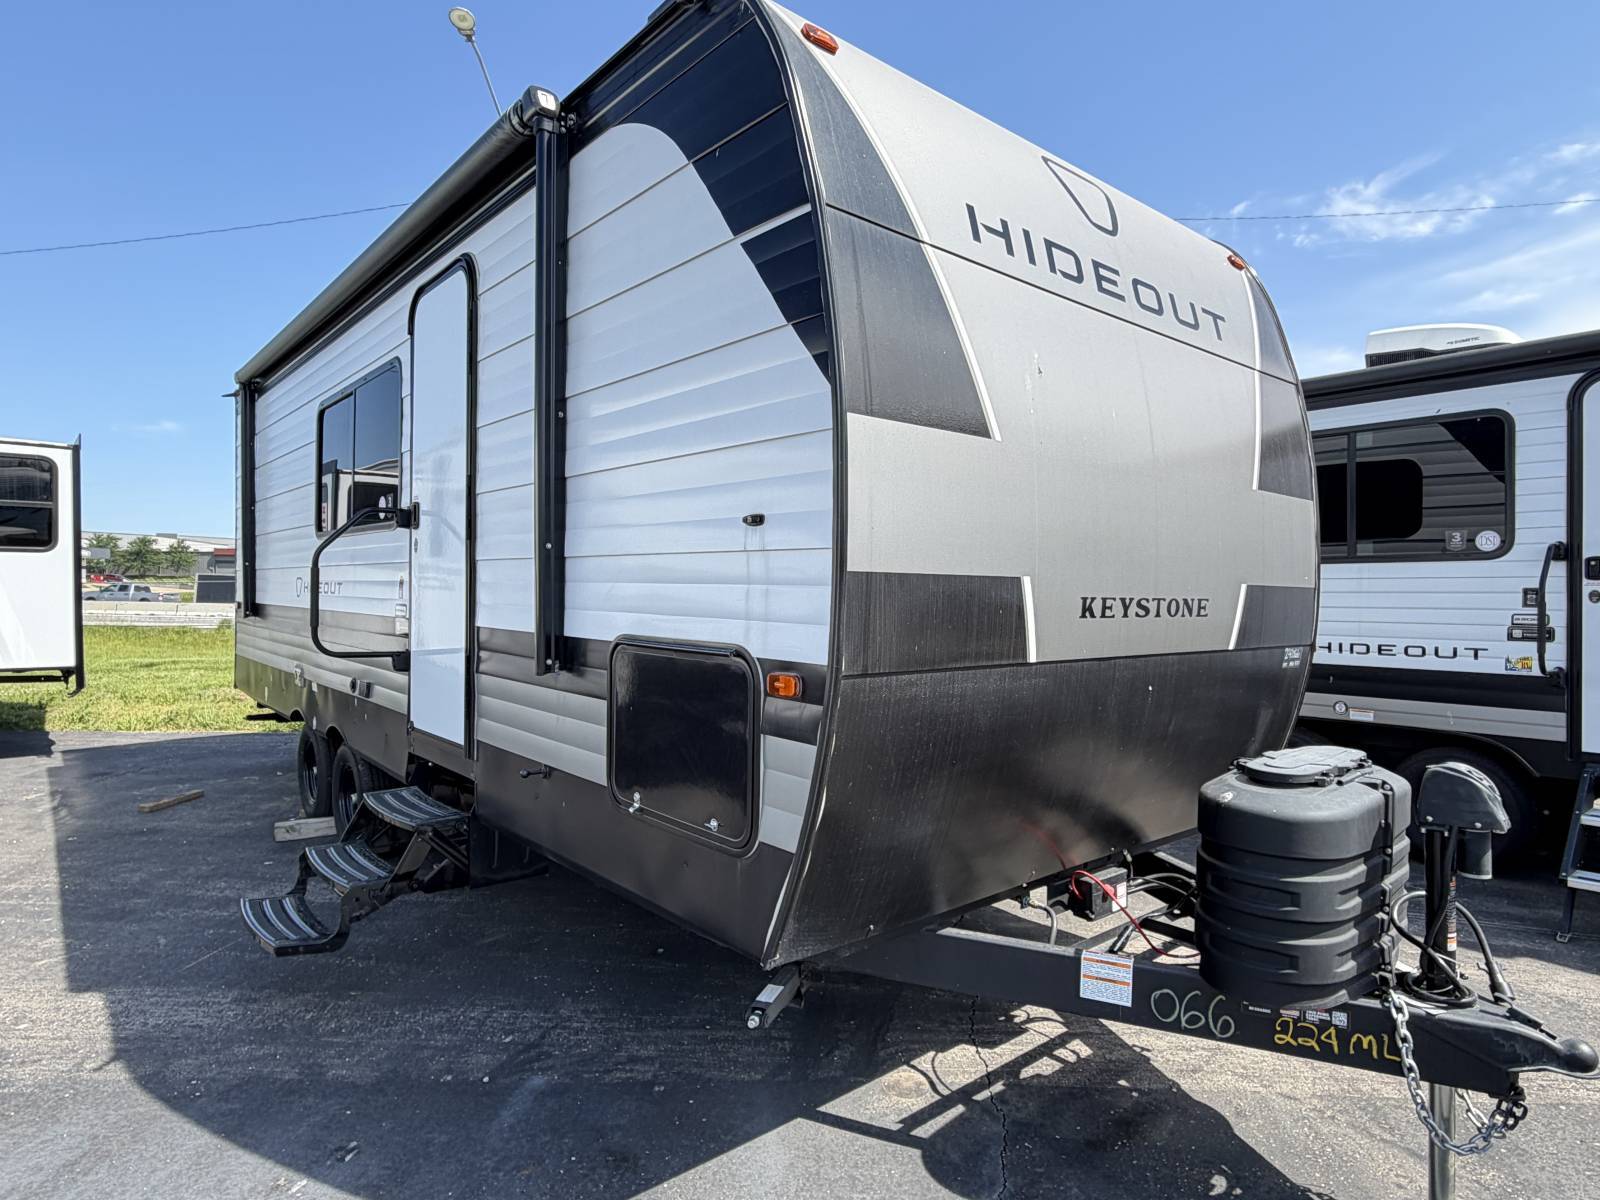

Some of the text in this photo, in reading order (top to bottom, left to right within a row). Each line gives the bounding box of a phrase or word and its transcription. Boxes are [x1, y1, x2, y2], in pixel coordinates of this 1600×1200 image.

[965, 202, 1226, 341] HIDEOUT
[1451, 532, 1462, 541] 3
[303, 581, 343, 595] HEOUT
[1079, 596, 1210, 619] KEYSTONE
[1150, 988, 1236, 1039] 066
[1273, 1016, 1340, 1055] 224
